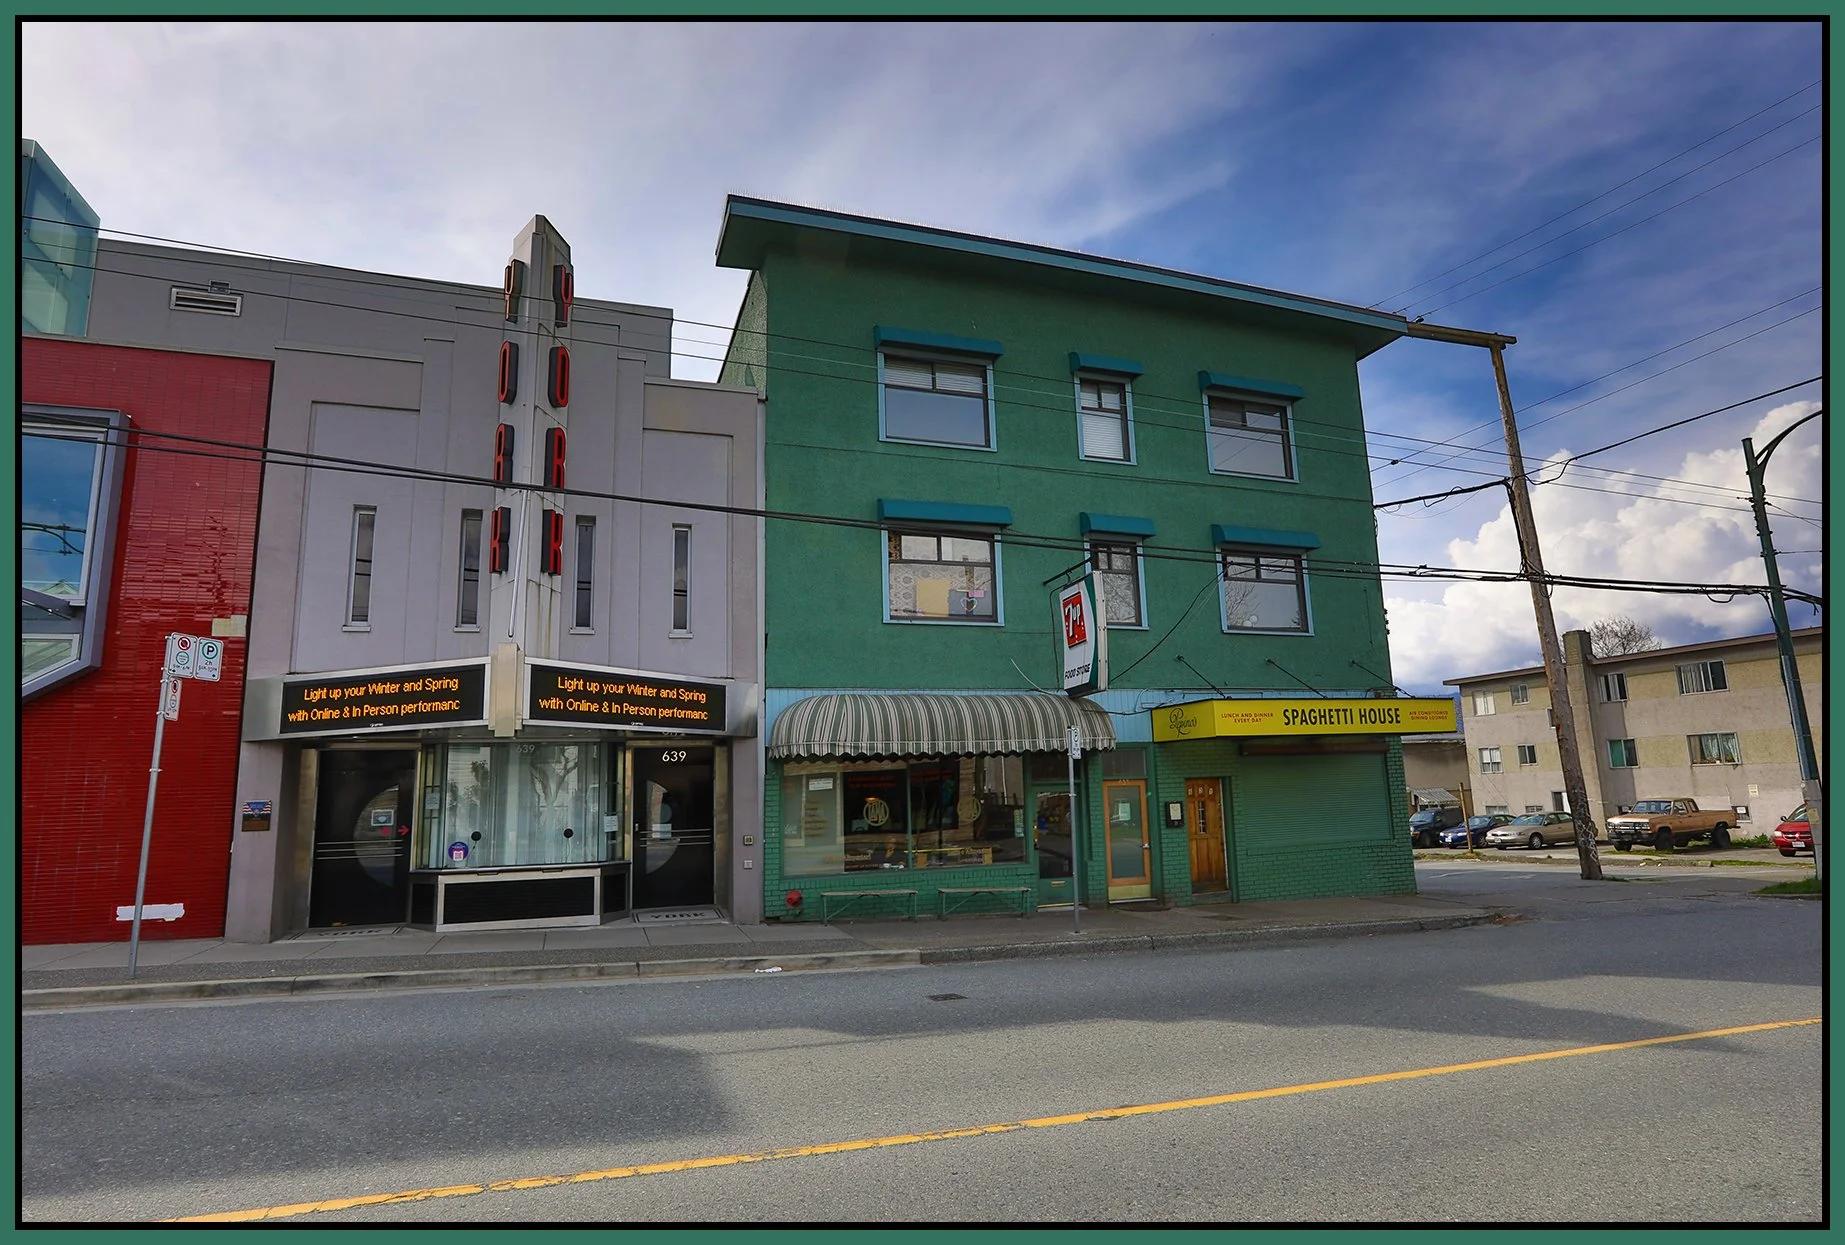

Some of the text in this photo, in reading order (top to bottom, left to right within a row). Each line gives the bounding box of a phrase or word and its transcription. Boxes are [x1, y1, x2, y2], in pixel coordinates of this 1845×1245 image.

[489, 259, 523, 574] YORK
[541, 264, 573, 576] YORK
[1065, 664, 1091, 679] FOOD STORE
[304, 677, 459, 703] Light up your Winter and Spring
[557, 676, 707, 703] Light up your Winter and Spring
[288, 700, 460, 722] with Online & In Person performanc
[539, 697, 709, 721] with Online & In Person performanc
[1282, 707, 1401, 726] SPAGHETTI HOUSE
[661, 750, 687, 762] 639
